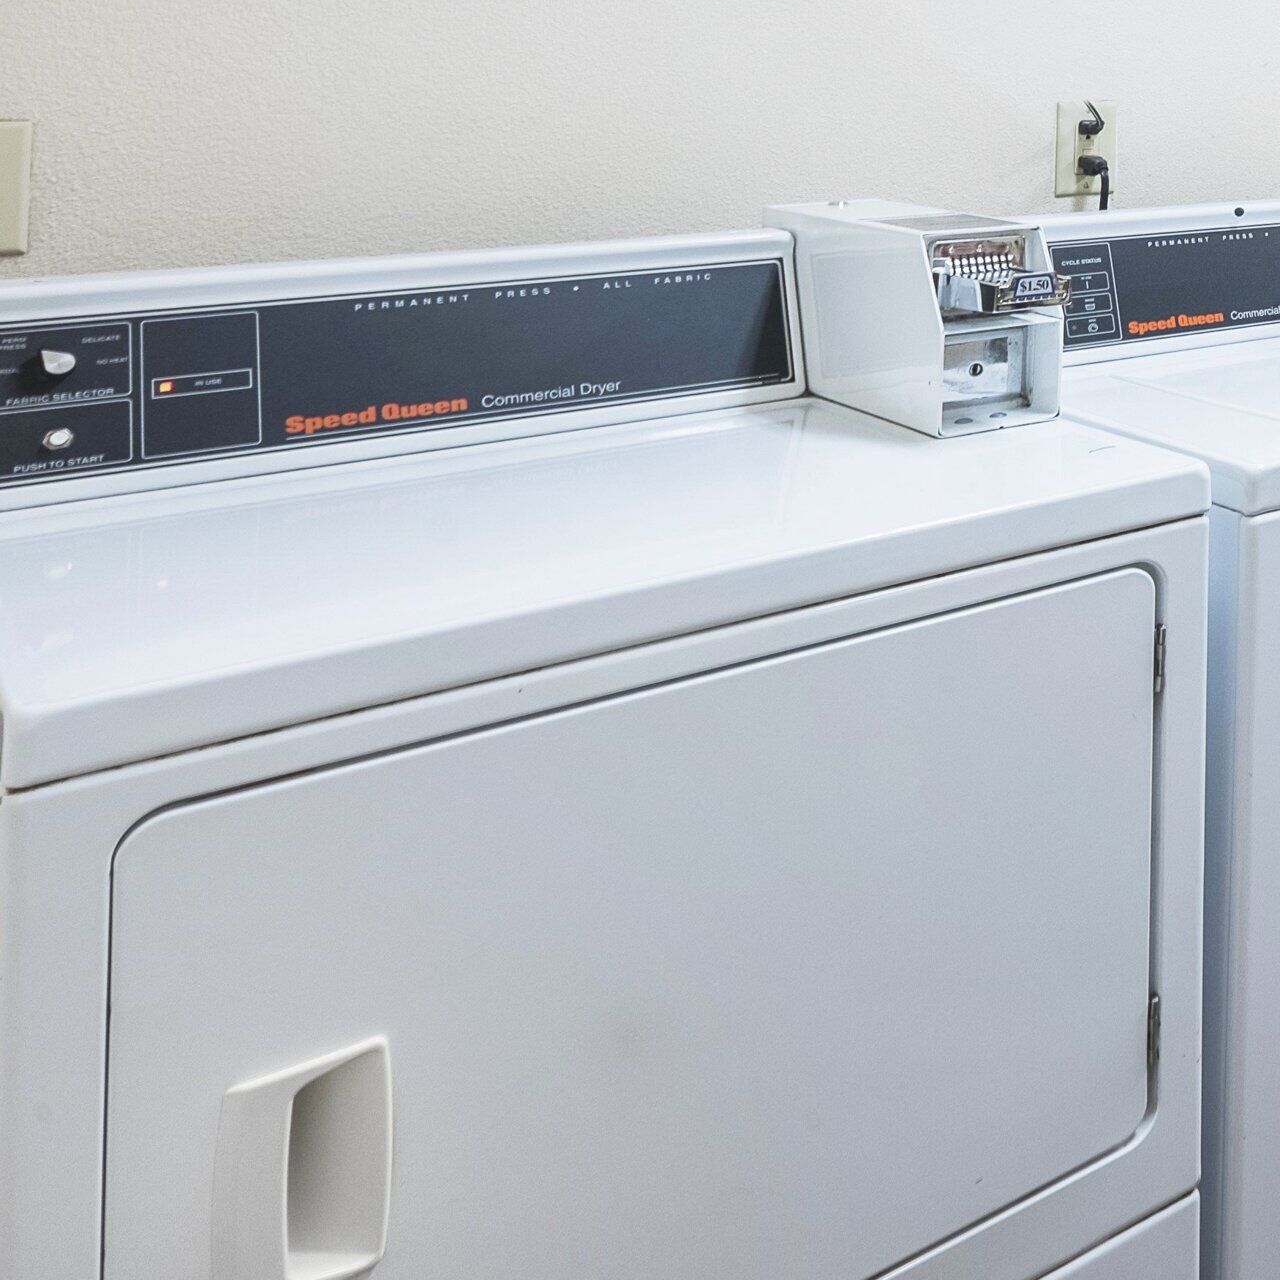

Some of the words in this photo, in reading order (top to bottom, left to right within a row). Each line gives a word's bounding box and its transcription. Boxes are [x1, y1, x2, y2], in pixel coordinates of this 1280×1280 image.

[1147, 236, 1210, 248] PERMANENT
[1222, 232, 1254, 241] PRESS
[1061, 259, 1080, 267] CYCLE
[1081, 257, 1102, 265] STATUS
[354, 293, 471, 312] PERMANENT
[494, 286, 552, 300] PRESS
[602, 279, 633, 290] ALL
[653, 272, 712, 285] FABRIC
[1019, 279, 1049, 293] $1.50
[1128, 316, 1177, 335] Speed
[1178, 311, 1225, 327] Queen
[81, 334, 120, 344] DELICATE
[205, 378, 222, 386] USE
[5, 395, 50, 407] FABRIC
[52, 388, 115, 402] SELECTOR
[284, 406, 377, 435] Speed
[381, 397, 469, 421] Queen
[481, 383, 575, 409] Commercial
[580, 379, 622, 396] Dryer
[13, 461, 47, 474] PUSH
[48, 460, 64, 469] TO
[67, 454, 106, 467] START
